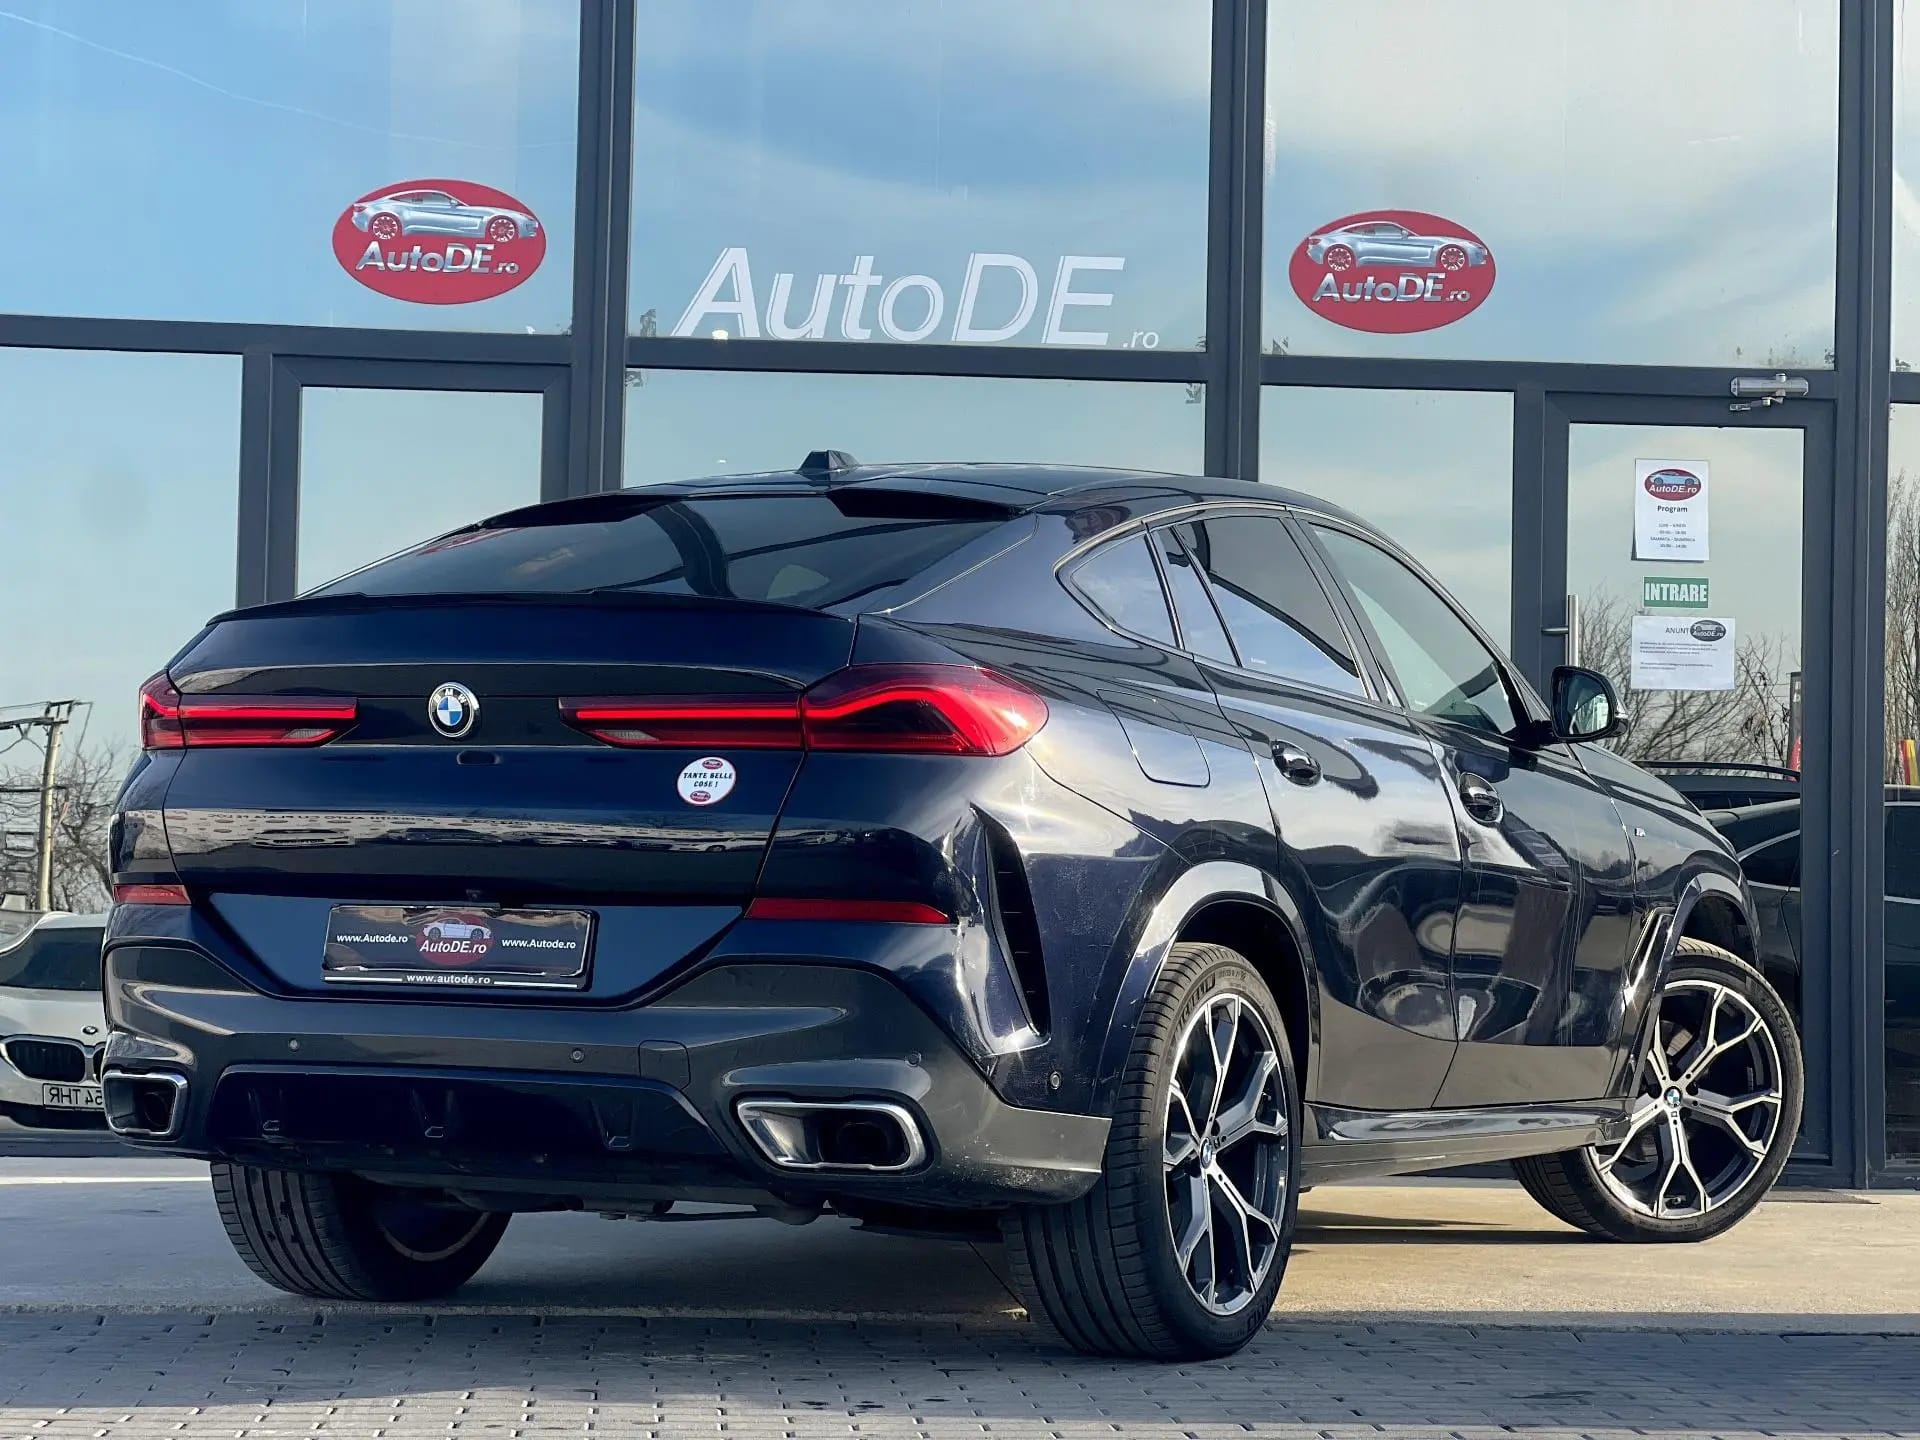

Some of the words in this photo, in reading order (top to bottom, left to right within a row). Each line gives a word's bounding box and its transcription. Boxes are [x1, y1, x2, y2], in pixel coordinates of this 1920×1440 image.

[1657, 505, 1688, 514] Program
[1644, 583, 1707, 602] INTRARE
[432, 688, 467, 704] BMW
[336, 934, 408, 945] www.Autode.ro
[501, 938, 576, 950] www.Autode.ro
[419, 940, 487, 954] AutoDE.ro
[406, 974, 491, 985] www.autode.ro
